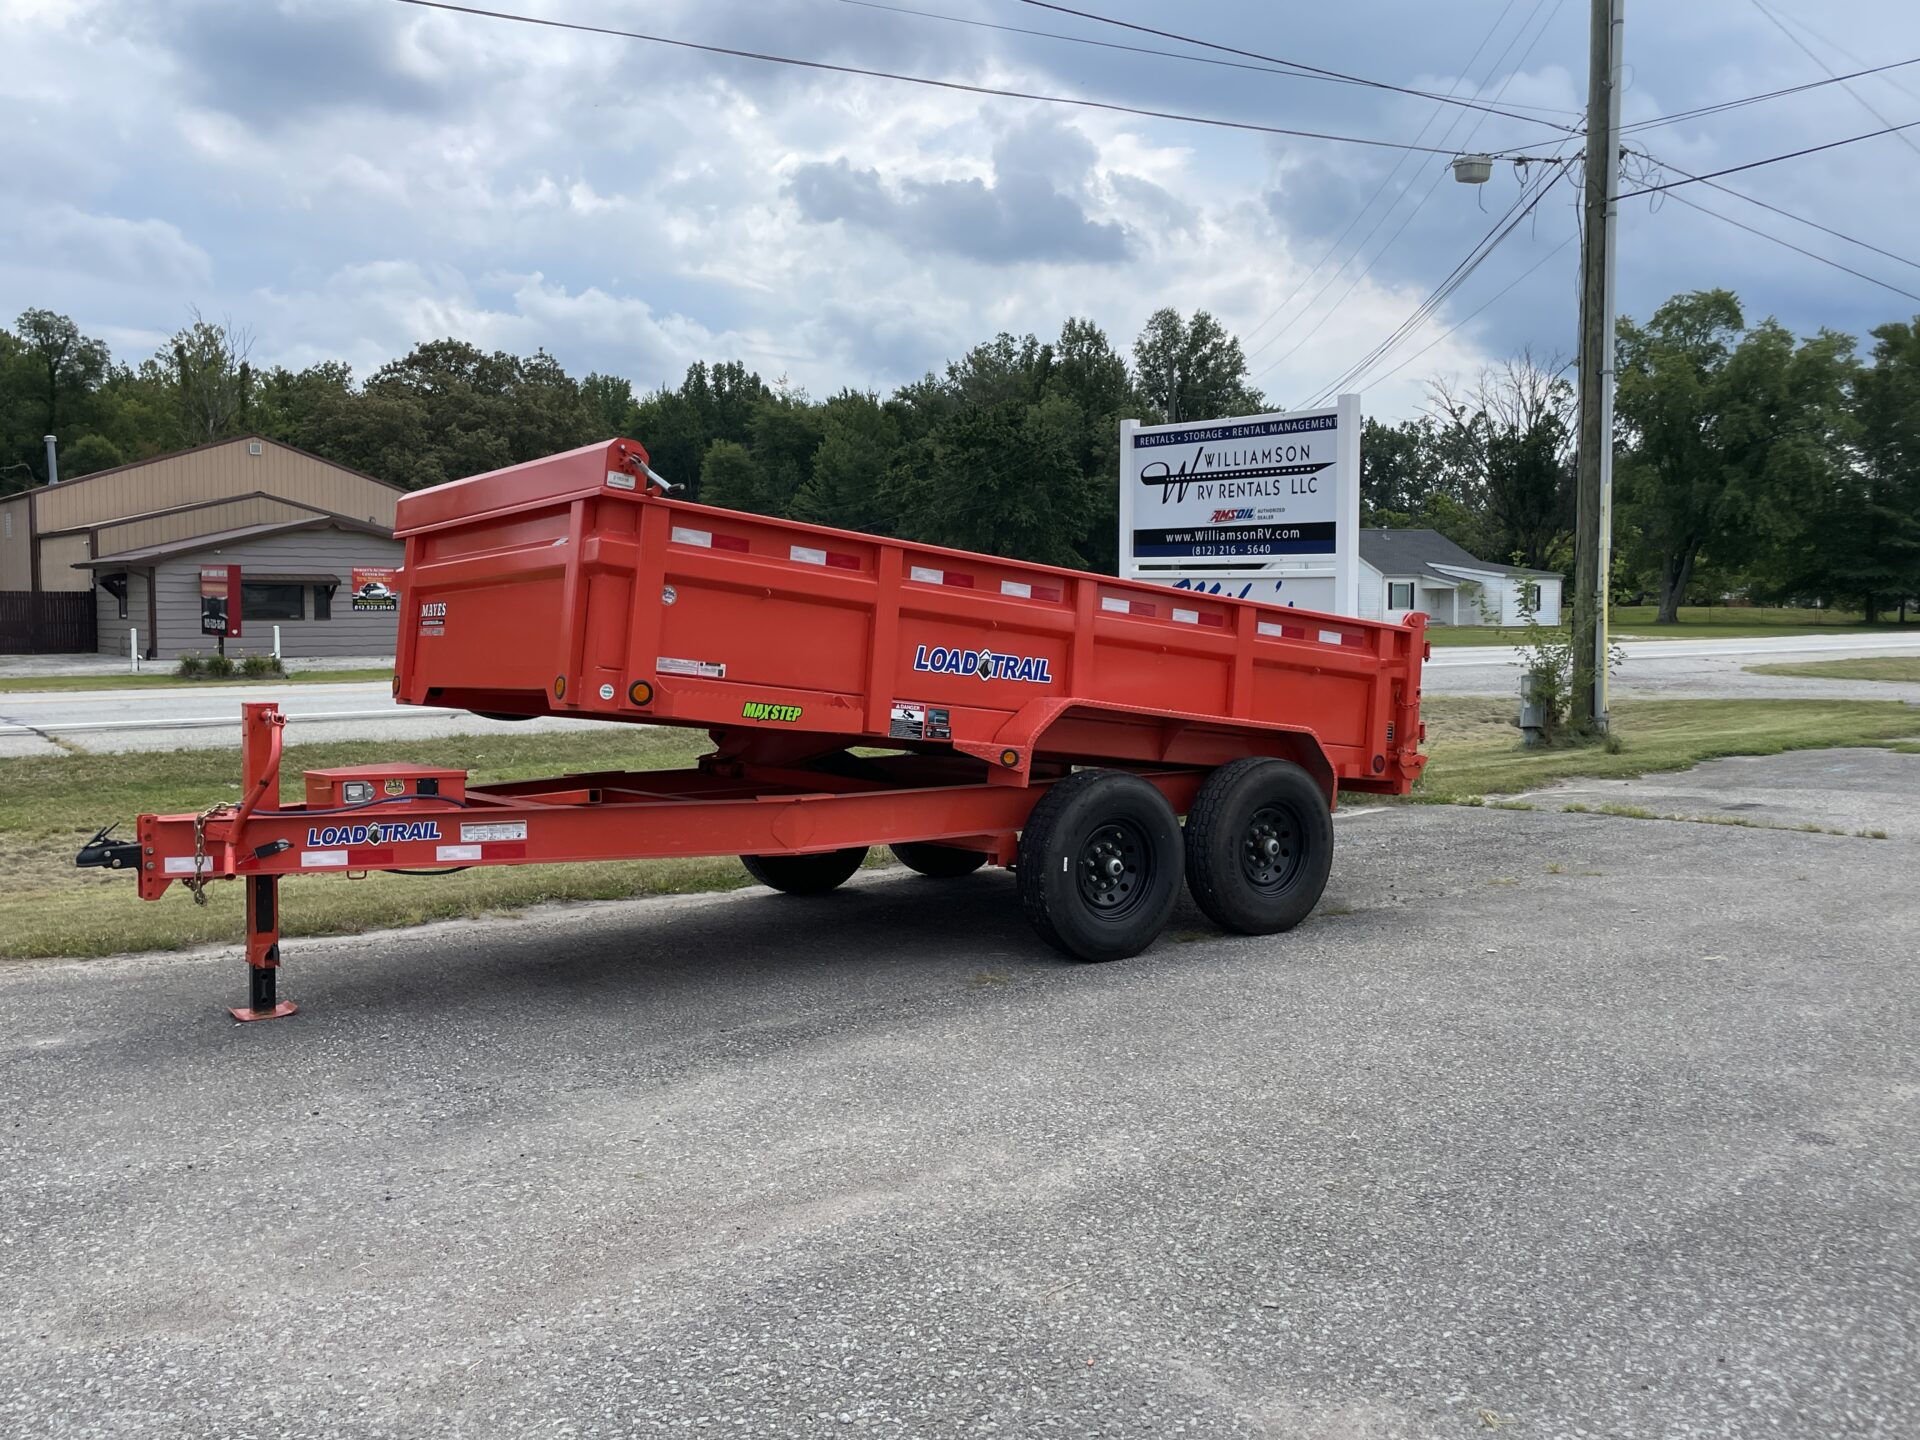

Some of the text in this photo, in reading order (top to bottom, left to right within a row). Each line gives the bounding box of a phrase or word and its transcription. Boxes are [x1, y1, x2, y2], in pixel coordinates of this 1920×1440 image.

[1140, 417, 1338, 446] RENTALS STORAGE RENTAL MANAGEMENT
[1204, 444, 1310, 468] WILLIAMSON
[1197, 477, 1318, 500] RV RENTALS LLC
[1210, 508, 1254, 523] AMSOIL
[1165, 528, 1300, 543] www.WilliamsonRV.com
[1191, 546, 1216, 556] (812)
[1219, 545, 1236, 555] 216
[1247, 544, 1271, 554] 5640
[421, 602, 447, 617] MAYES
[913, 644, 1053, 684] LOAD TRAIL
[306, 826, 368, 847] LOAD
[379, 821, 442, 842] TRAIL
